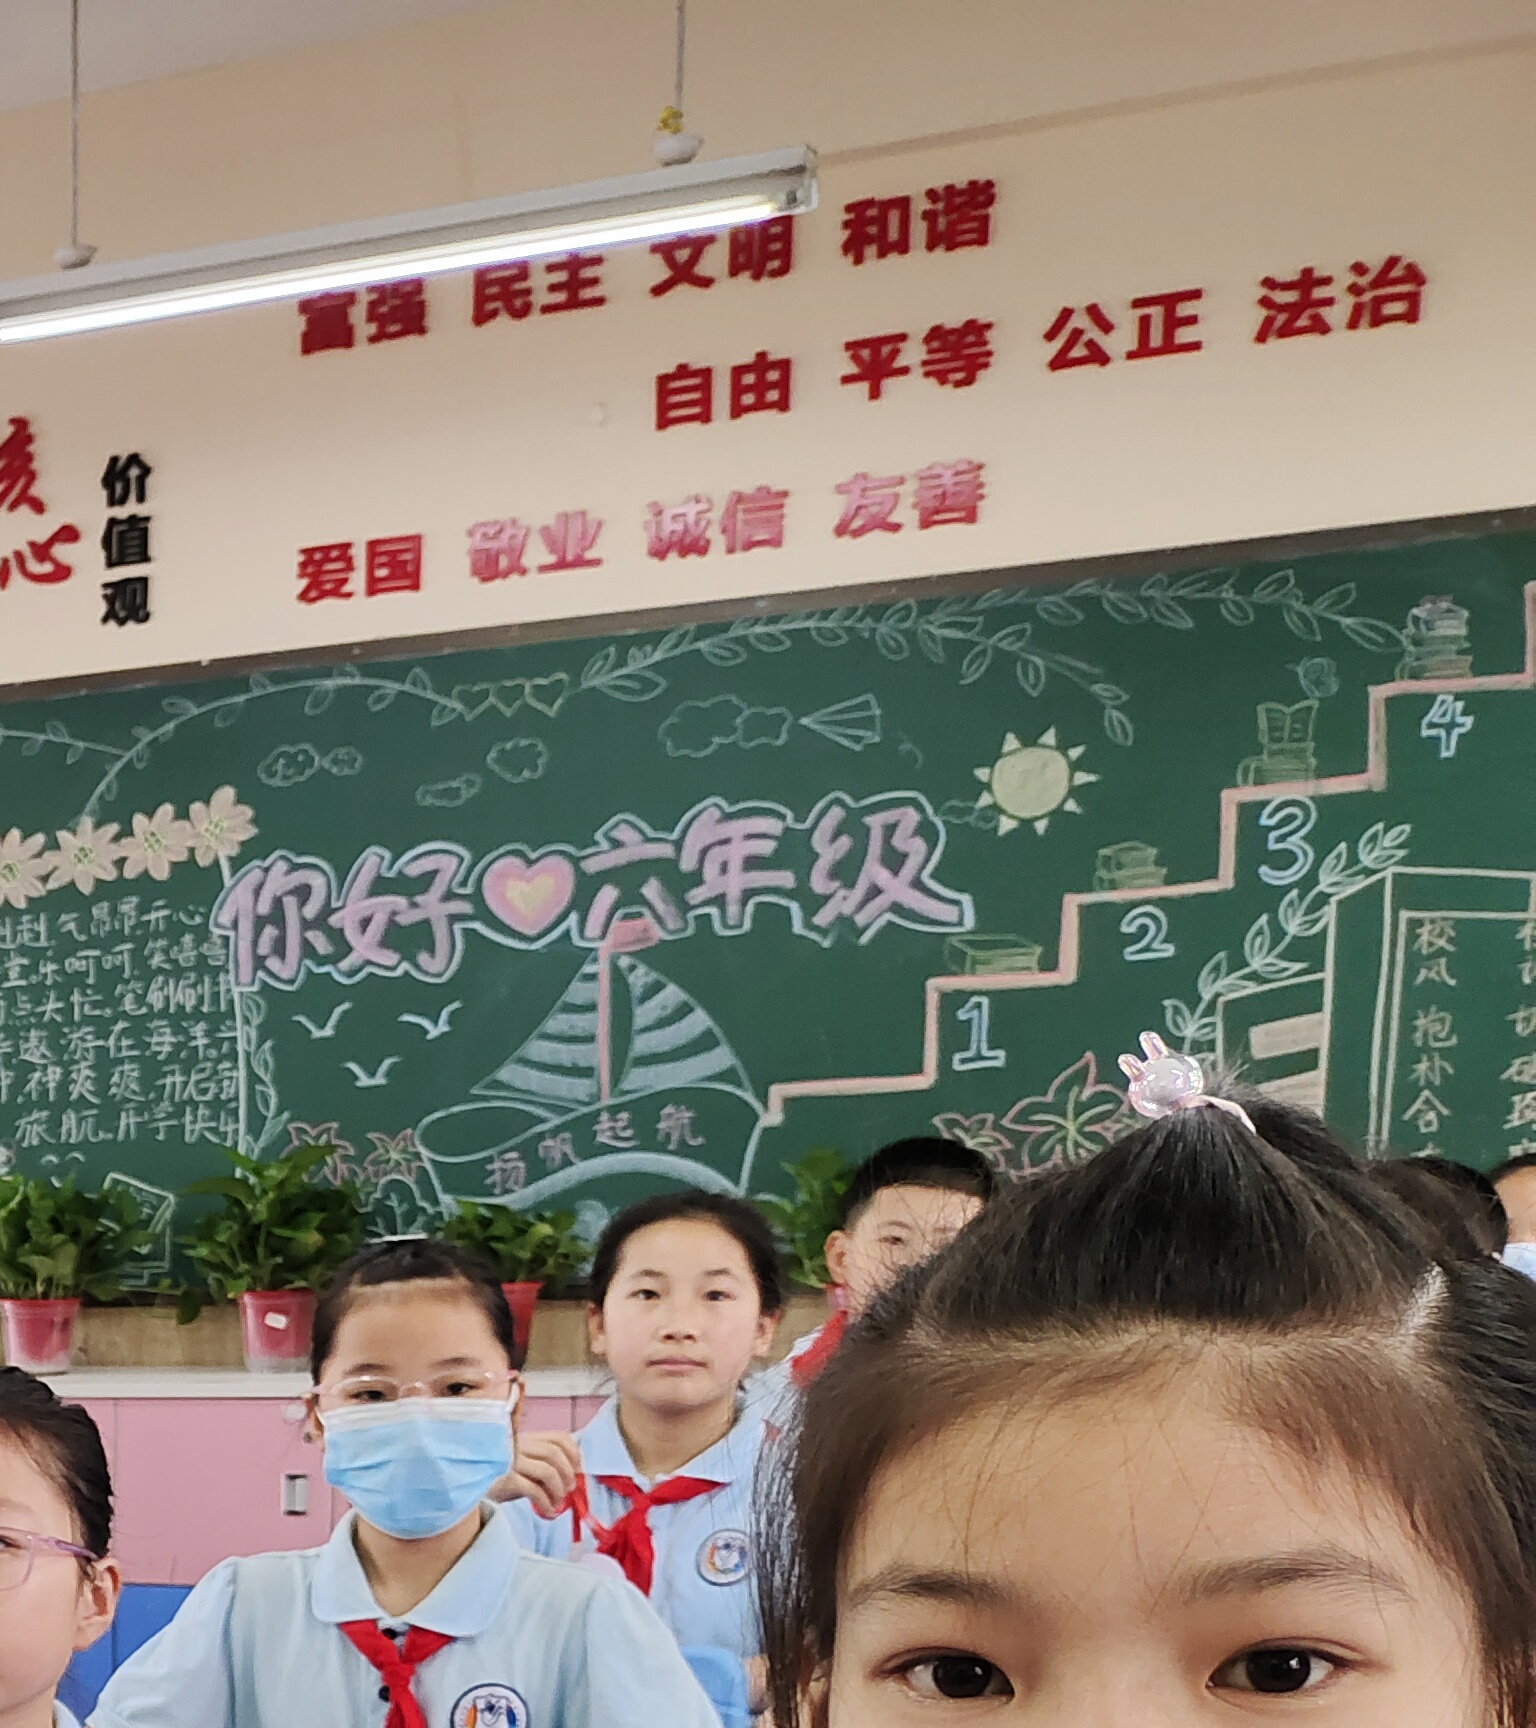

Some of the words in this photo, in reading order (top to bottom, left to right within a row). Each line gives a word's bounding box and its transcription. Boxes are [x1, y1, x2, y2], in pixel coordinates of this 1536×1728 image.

[298, 277, 428, 356] 富强
[471, 251, 607, 328] 民主
[648, 212, 795, 298] 文明
[842, 178, 997, 266] 和谐
[655, 350, 793, 431] 自由
[840, 317, 995, 401] 平等
[1042, 286, 1204, 372] 公正
[1253, 255, 1428, 344] 法治
[101, 452, 153, 628] 价值观
[297, 533, 423, 605] 爱国
[466, 509, 605, 585] 敬业
[645, 484, 792, 562] 诚信
[833, 459, 988, 539] 友善
[1420, 693, 1476, 759] 4
[1257, 796, 1319, 885] 3
[216, 850, 475, 990] 你好
[576, 796, 968, 944] 六年级
[1118, 905, 1176, 961] 2
[1411, 915, 1458, 987] 校风
[952, 995, 1006, 1071] 1
[483, 1103, 707, 1195] 扬帆起航
